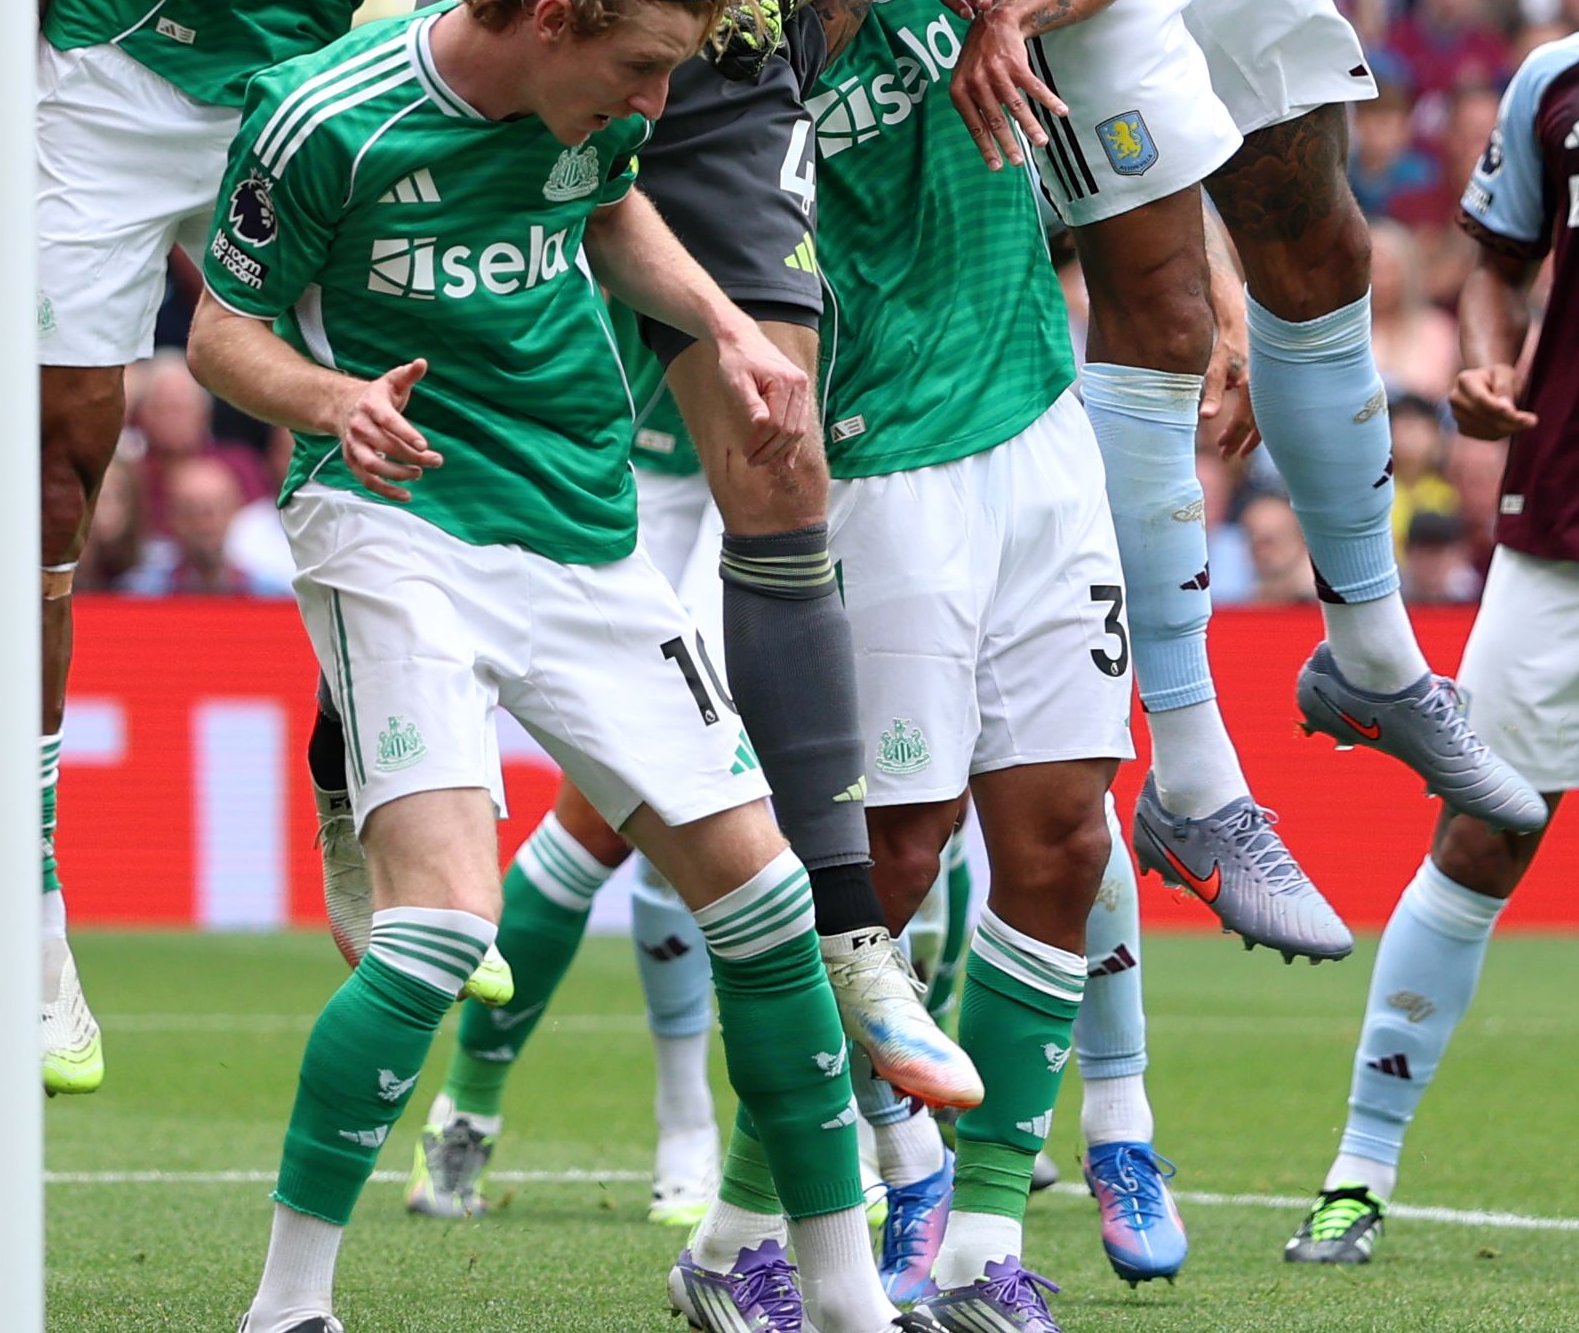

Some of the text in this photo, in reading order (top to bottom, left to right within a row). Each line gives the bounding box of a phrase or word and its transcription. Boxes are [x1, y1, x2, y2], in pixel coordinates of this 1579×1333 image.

[871, 13, 963, 126] sela
[222, 255, 263, 290] racism
[227, 245, 262, 276] room
[442, 225, 569, 299] sela
